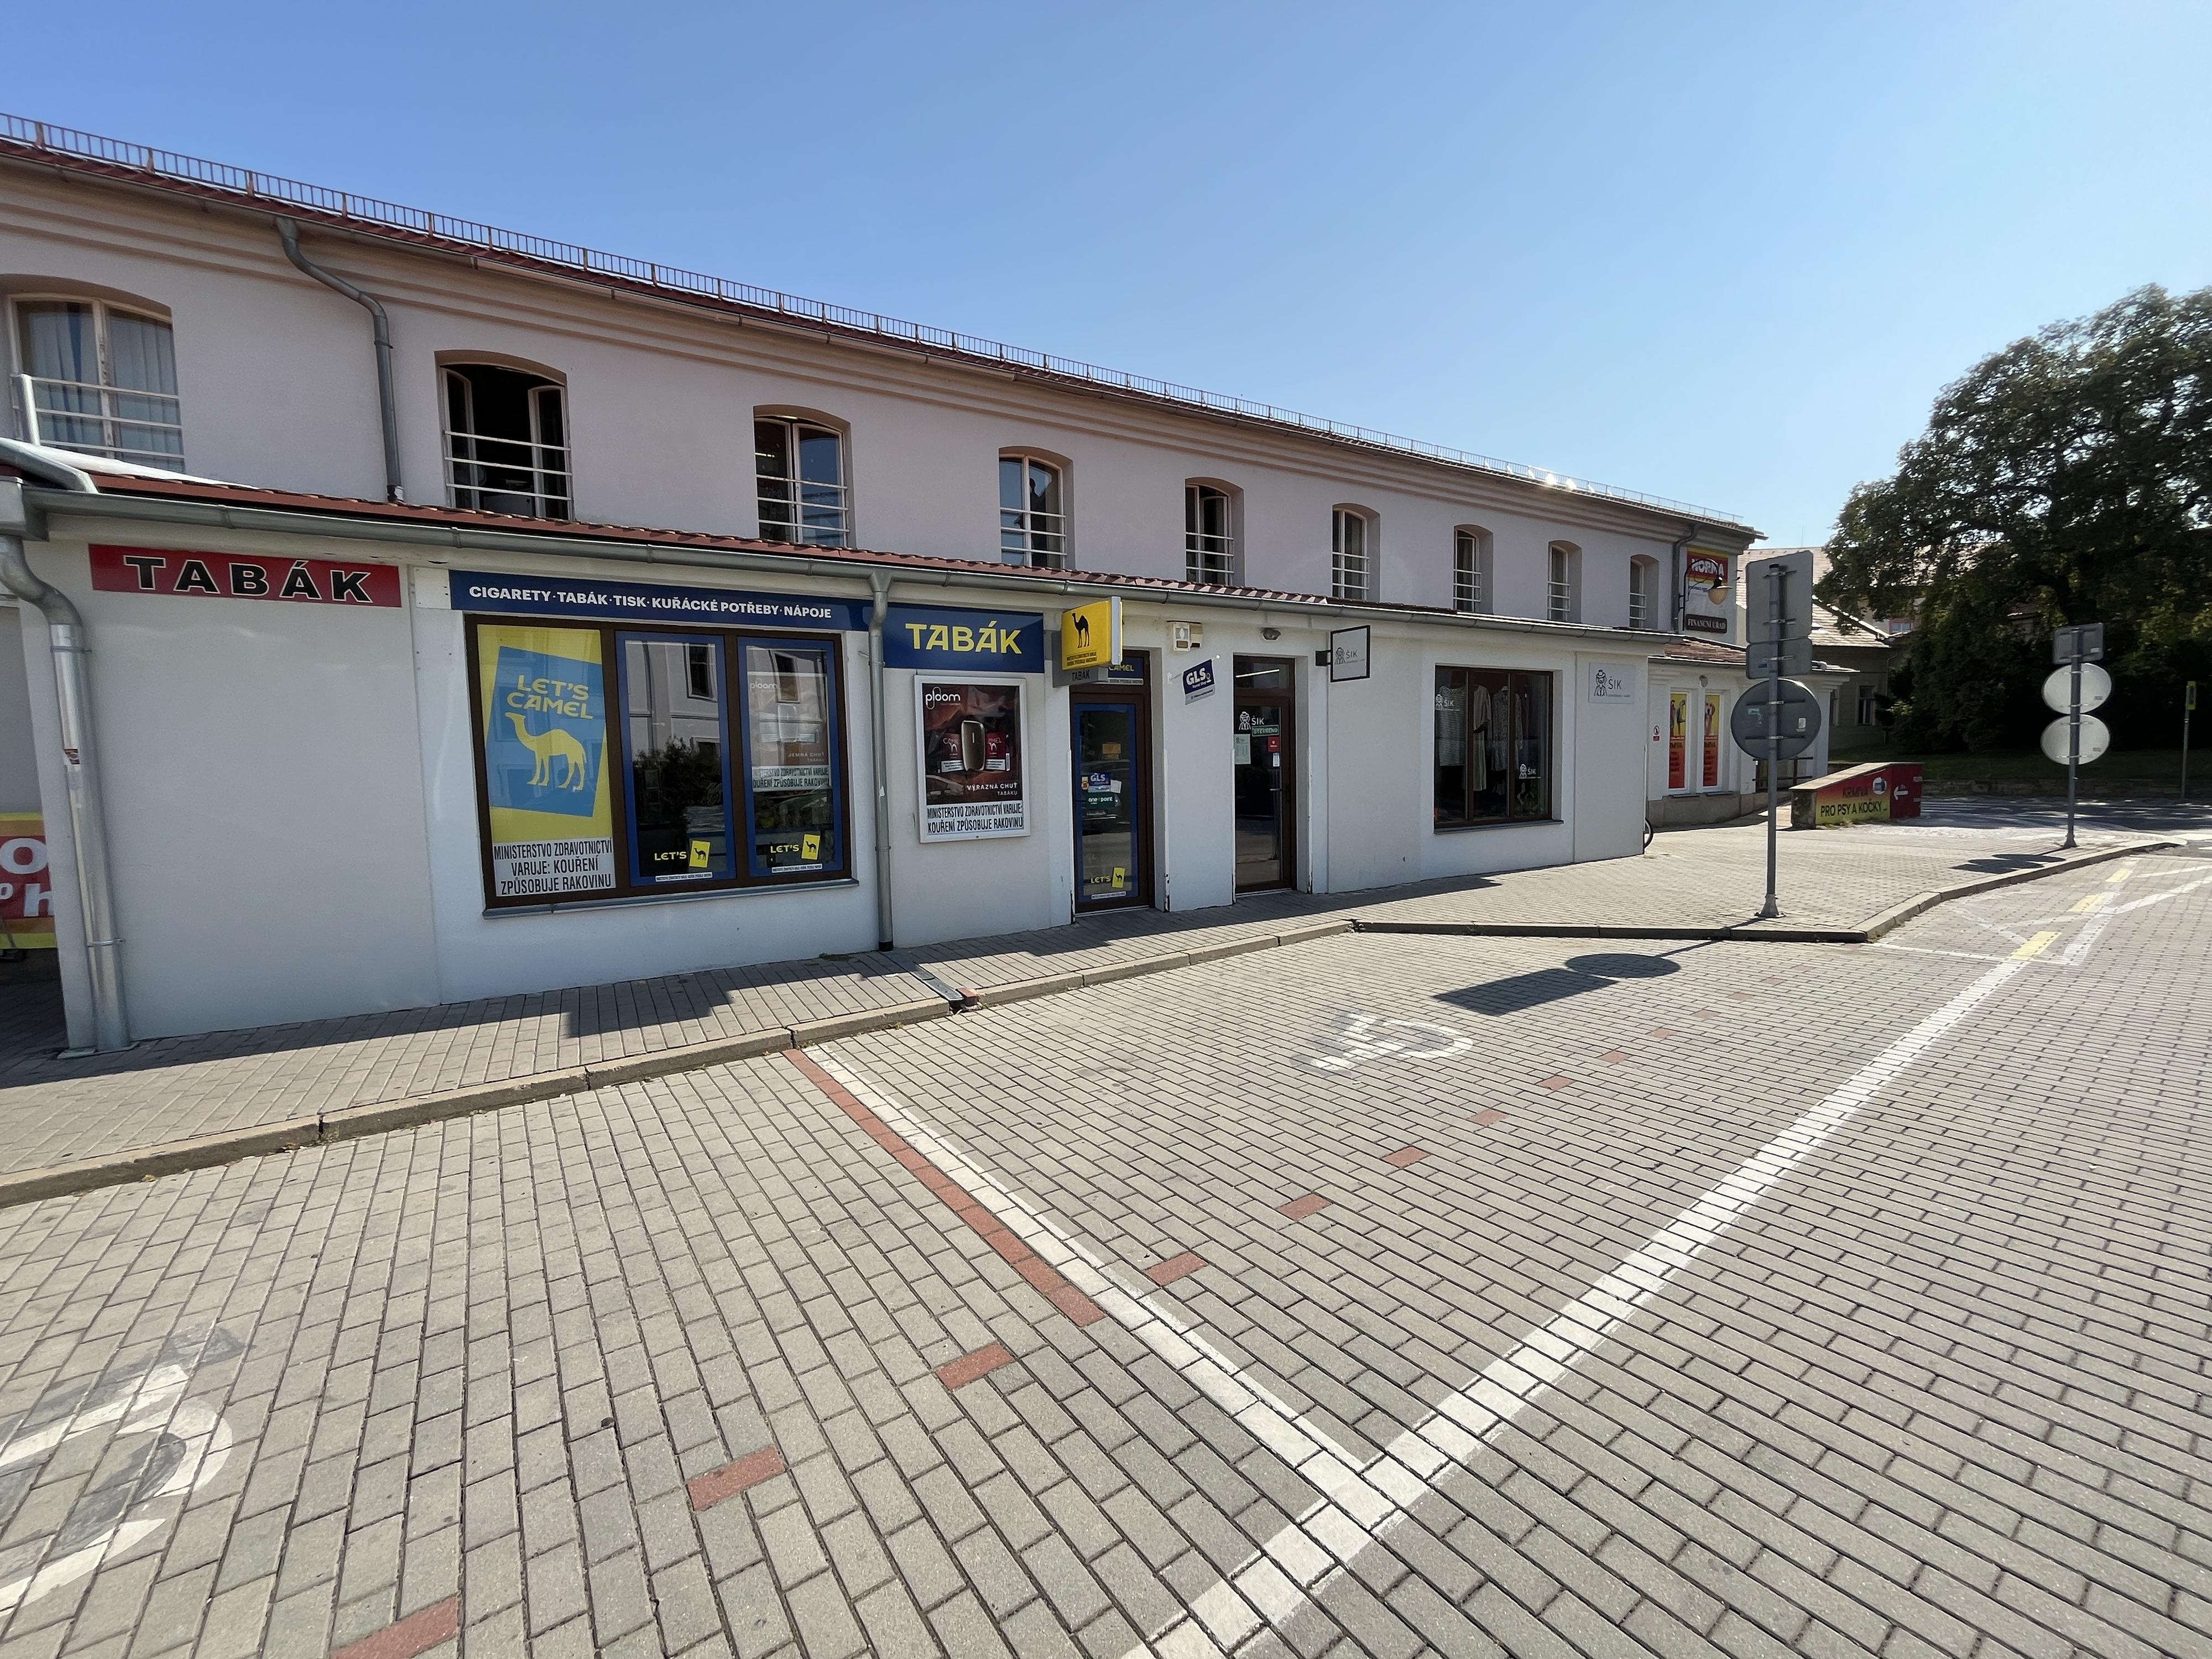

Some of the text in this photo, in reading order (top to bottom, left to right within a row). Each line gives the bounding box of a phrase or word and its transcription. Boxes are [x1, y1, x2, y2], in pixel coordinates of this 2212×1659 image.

[123, 555, 373, 603] TABÁK
[469, 586, 832, 619] CIGARETY TABÁK TISK KUŘÁCKÉ POTŘEBY NÁPOJE
[905, 620, 1022, 654] TABÁK
[1345, 649, 1358, 659] ŠIK
[1186, 667, 1206, 685] GLS
[1608, 676, 1622, 690] ŠIK
[517, 675, 589, 701] LET'S
[507, 692, 593, 719] CAMEL
[925, 686, 961, 709] ploom
[1251, 715, 1265, 726] ŠIK
[1090, 774, 1106, 782] GLS
[967, 784, 998, 792] VÝRAZNÁ
[1820, 805, 1836, 817] PRO
[1837, 802, 1851, 816] PSY
[1851, 805, 1858, 814] A
[927, 817, 1023, 833] KOUŘENÍ ZPŮSOBUJE RAKOVINU
[494, 837, 612, 860] MINISTERSTVO ZDRAVOTNICTVÍ
[654, 851, 687, 861] LET'S
[770, 844, 800, 853] LET'S
[511, 854, 599, 876] VARUJE: KOUŘENÍ
[500, 873, 611, 895] ZPŮSOBUJE RAKOVINU
